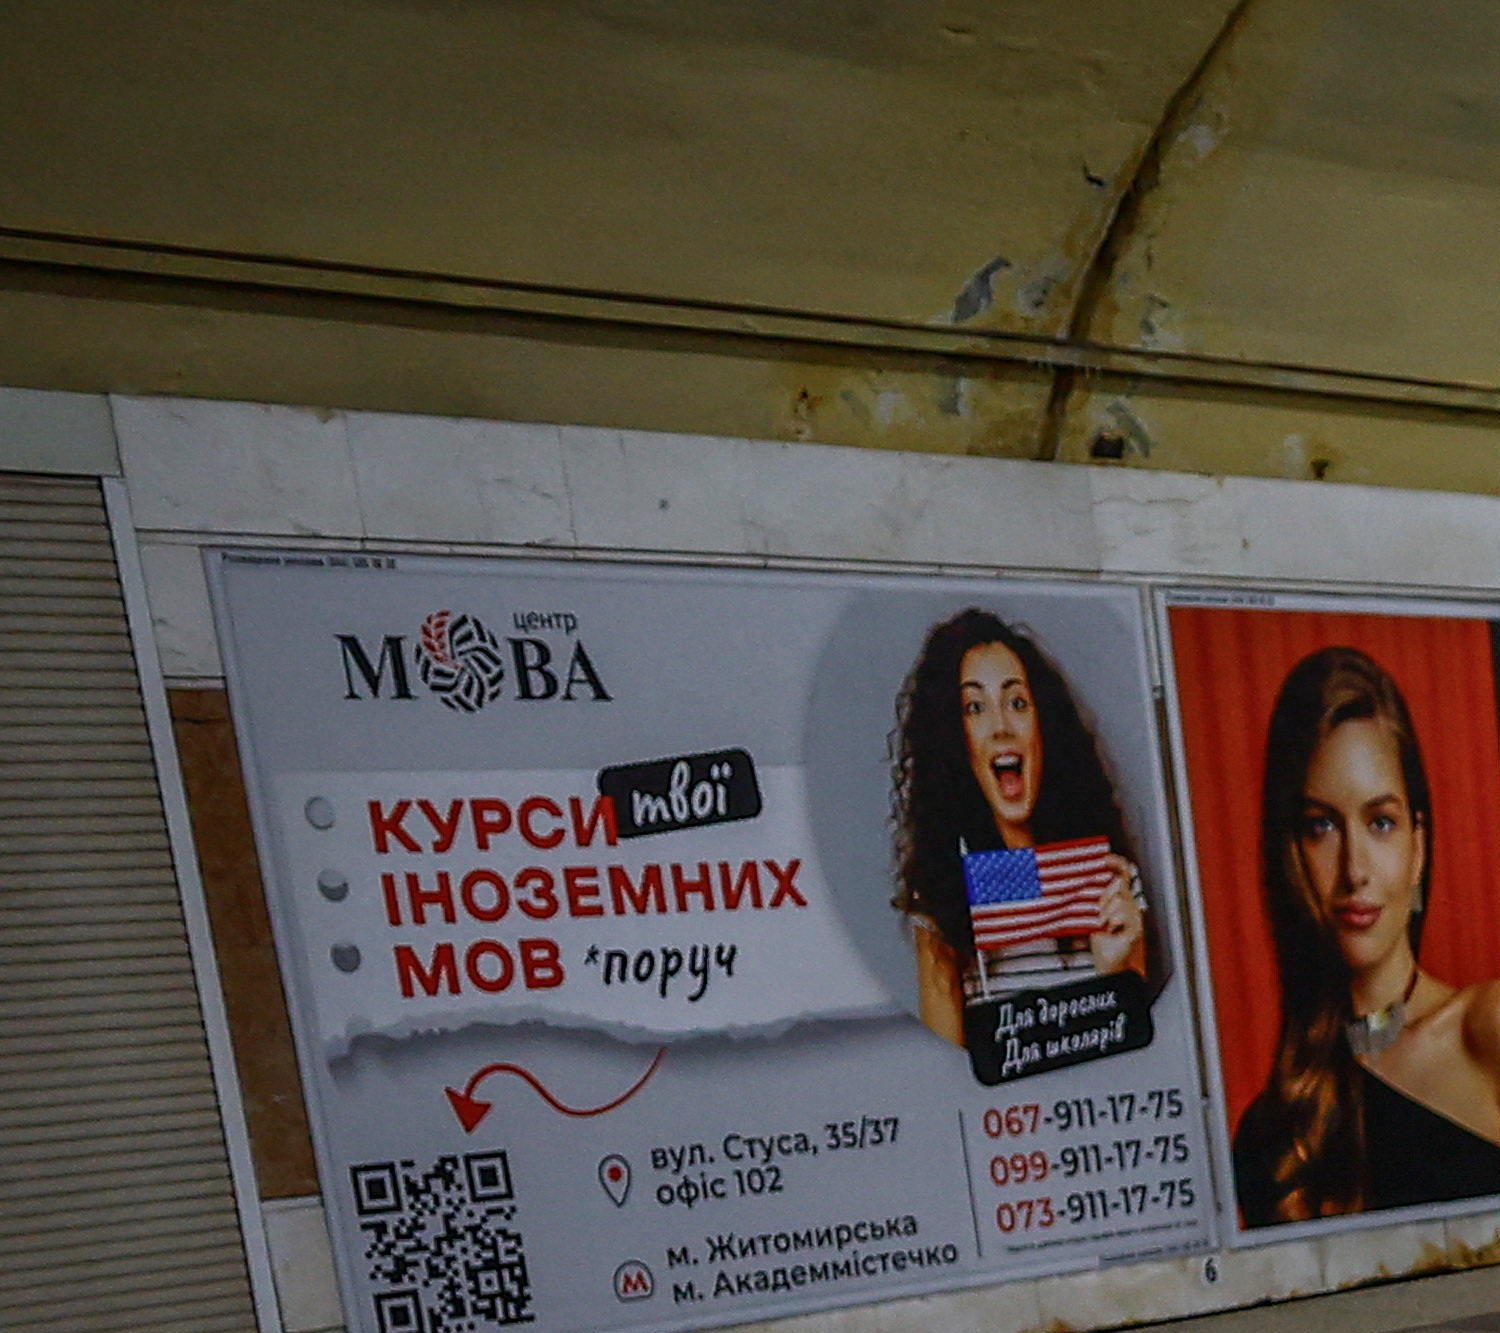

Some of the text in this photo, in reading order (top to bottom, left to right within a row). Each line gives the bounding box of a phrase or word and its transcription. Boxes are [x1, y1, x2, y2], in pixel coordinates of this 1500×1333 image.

[513, 611, 577, 636] центр
[631, 760, 733, 828] твої
[367, 795, 619, 853] КУРСИ
[379, 859, 808, 926] ІНОЗЕМНИХ
[393, 938, 566, 998] МОВ
[994, 1001, 1036, 1041] Для
[1002, 1037, 1044, 1077] Для
[982, 1088, 1185, 1140] 067-911-17-75
[650, 1114, 900, 1174] вул. Стуса, 35/37
[989, 1133, 1191, 1186] 099-911-17-75
[656, 1166, 784, 1210] офіс 102
[996, 1178, 1197, 1234] 073-911-17-75
[665, 1213, 920, 1270] м. Житомирська
[672, 1243, 960, 1306] м. Академмістечко
[1204, 1257, 1218, 1283] 6
